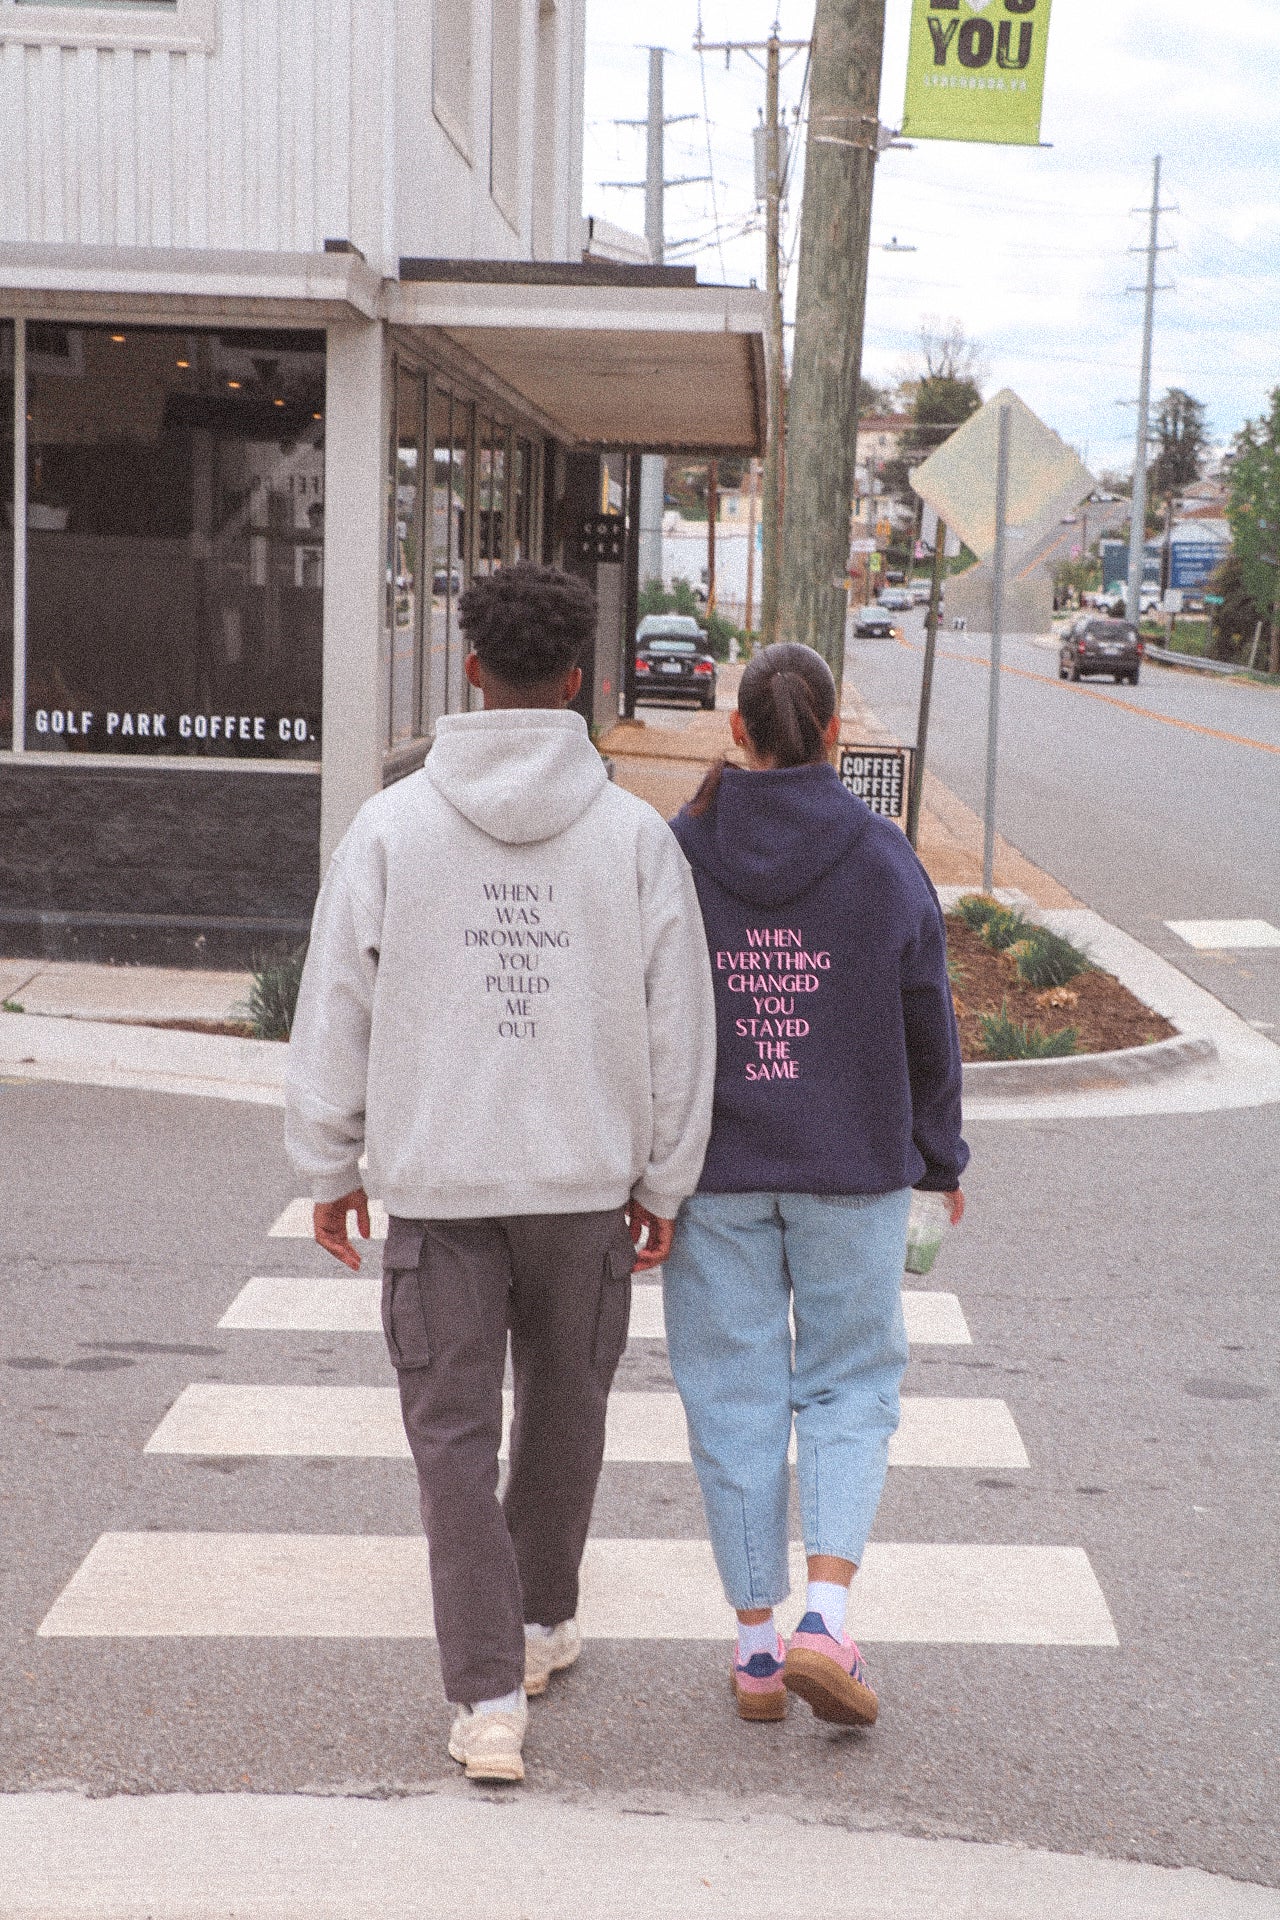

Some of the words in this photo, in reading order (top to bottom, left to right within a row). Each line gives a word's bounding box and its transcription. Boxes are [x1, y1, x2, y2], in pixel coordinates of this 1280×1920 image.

[926, 17, 1033, 70] YOU
[35, 709, 93, 734] GOLF
[106, 712, 166, 736] PARK
[179, 714, 265, 740] COFFEE
[278, 717, 315, 742] CO.
[842, 756, 902, 778] COFFEE
[483, 884, 539, 901] WHEN
[548, 884, 553, 901] I
[496, 907, 540, 925] WAS
[464, 929, 570, 948] DROWNING
[746, 928, 802, 948] WHEN
[499, 952, 538, 971] YOU
[716, 951, 831, 970] EVERYTHING
[486, 975, 550, 994] PULLED
[727, 973, 820, 993] CHANGED
[505, 999, 532, 1016] ME
[753, 997, 795, 1015] YOU
[498, 1021, 538, 1038] OUT
[735, 1018, 810, 1037] STAYED
[755, 1041, 791, 1060] THE
[745, 1060, 799, 1081] SAME
